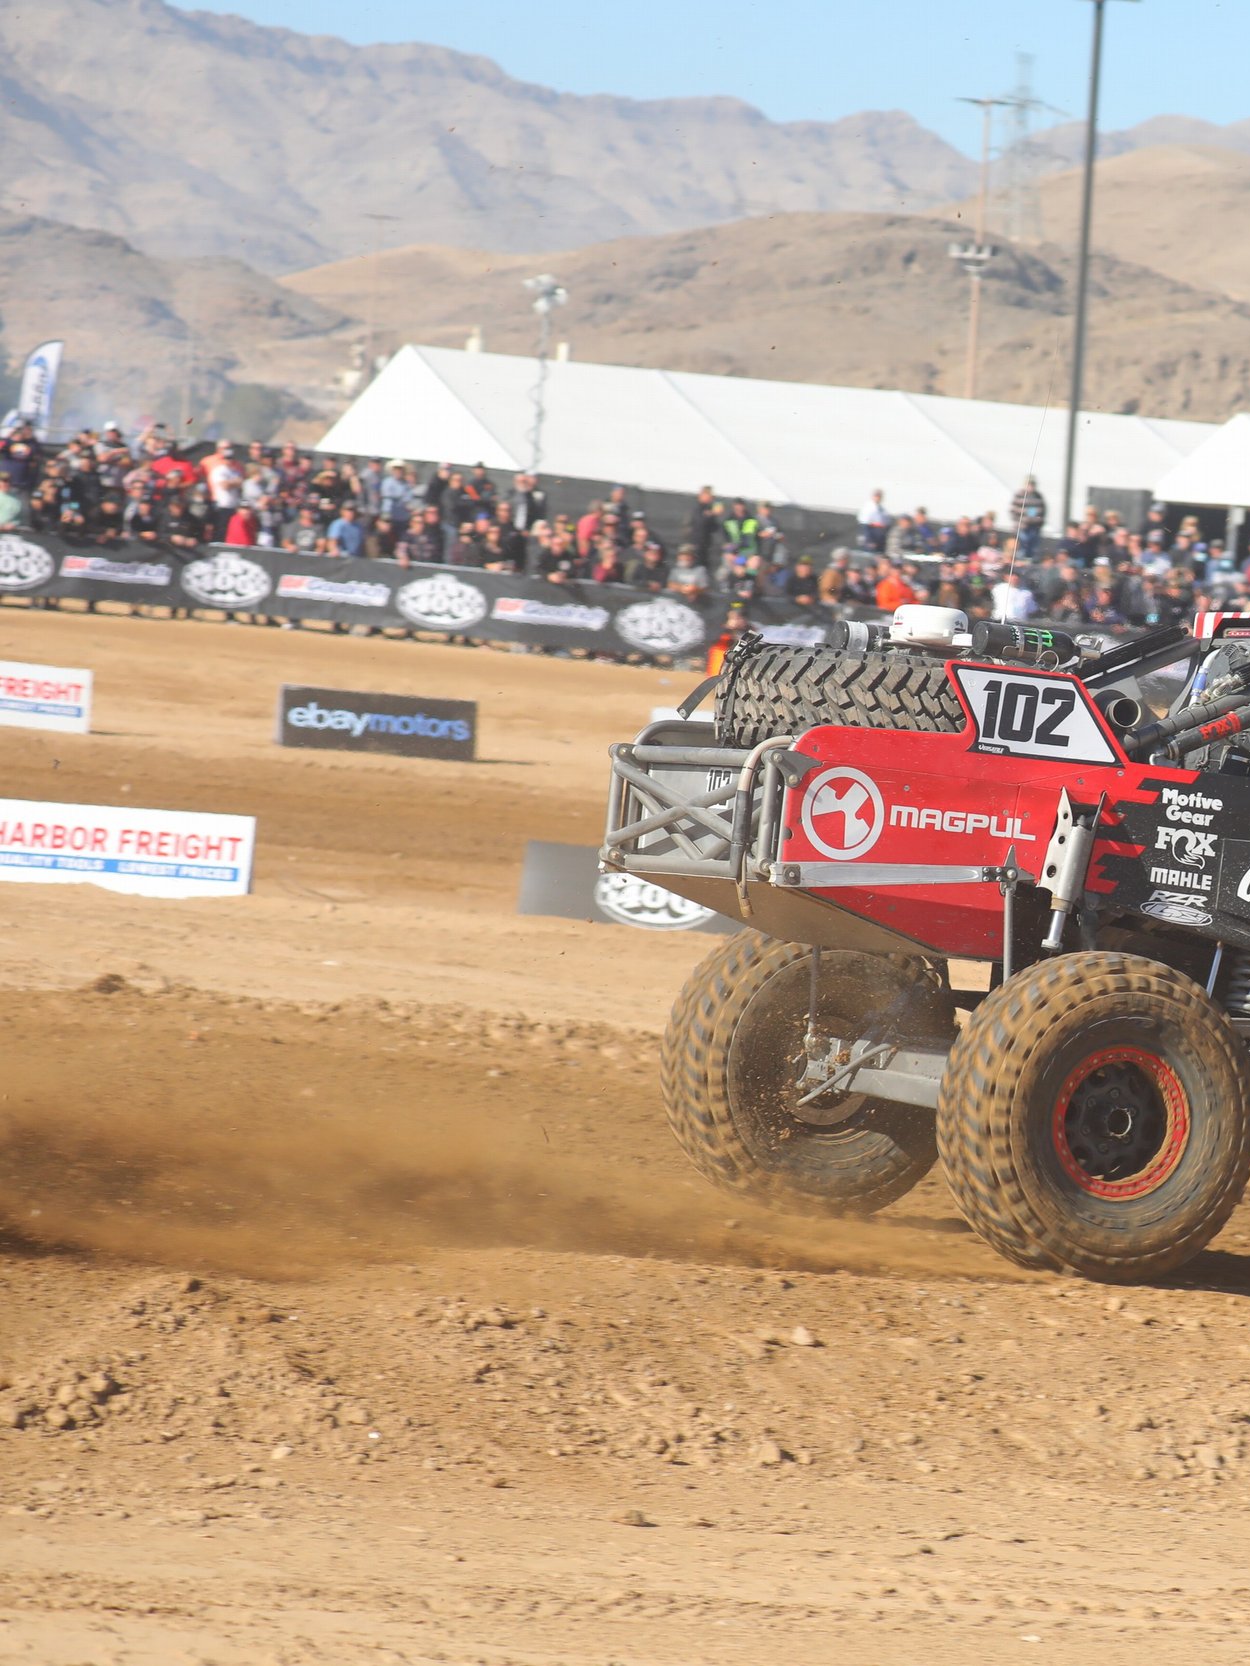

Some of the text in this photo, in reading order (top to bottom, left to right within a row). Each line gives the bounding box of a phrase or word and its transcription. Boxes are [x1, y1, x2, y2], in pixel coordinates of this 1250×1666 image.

[288, 702, 471, 741] ebaymotors
[982, 680, 1076, 747] 102
[1162, 787, 1223, 811] Motive
[1166, 805, 1214, 827] Gear
[0, 820, 243, 862] ARBOR FREIGHT
[889, 805, 1036, 841] MAGPUL
[1154, 826, 1218, 869] FOX
[1150, 867, 1212, 891] MAHLE
[1148, 889, 1209, 908] RZR
